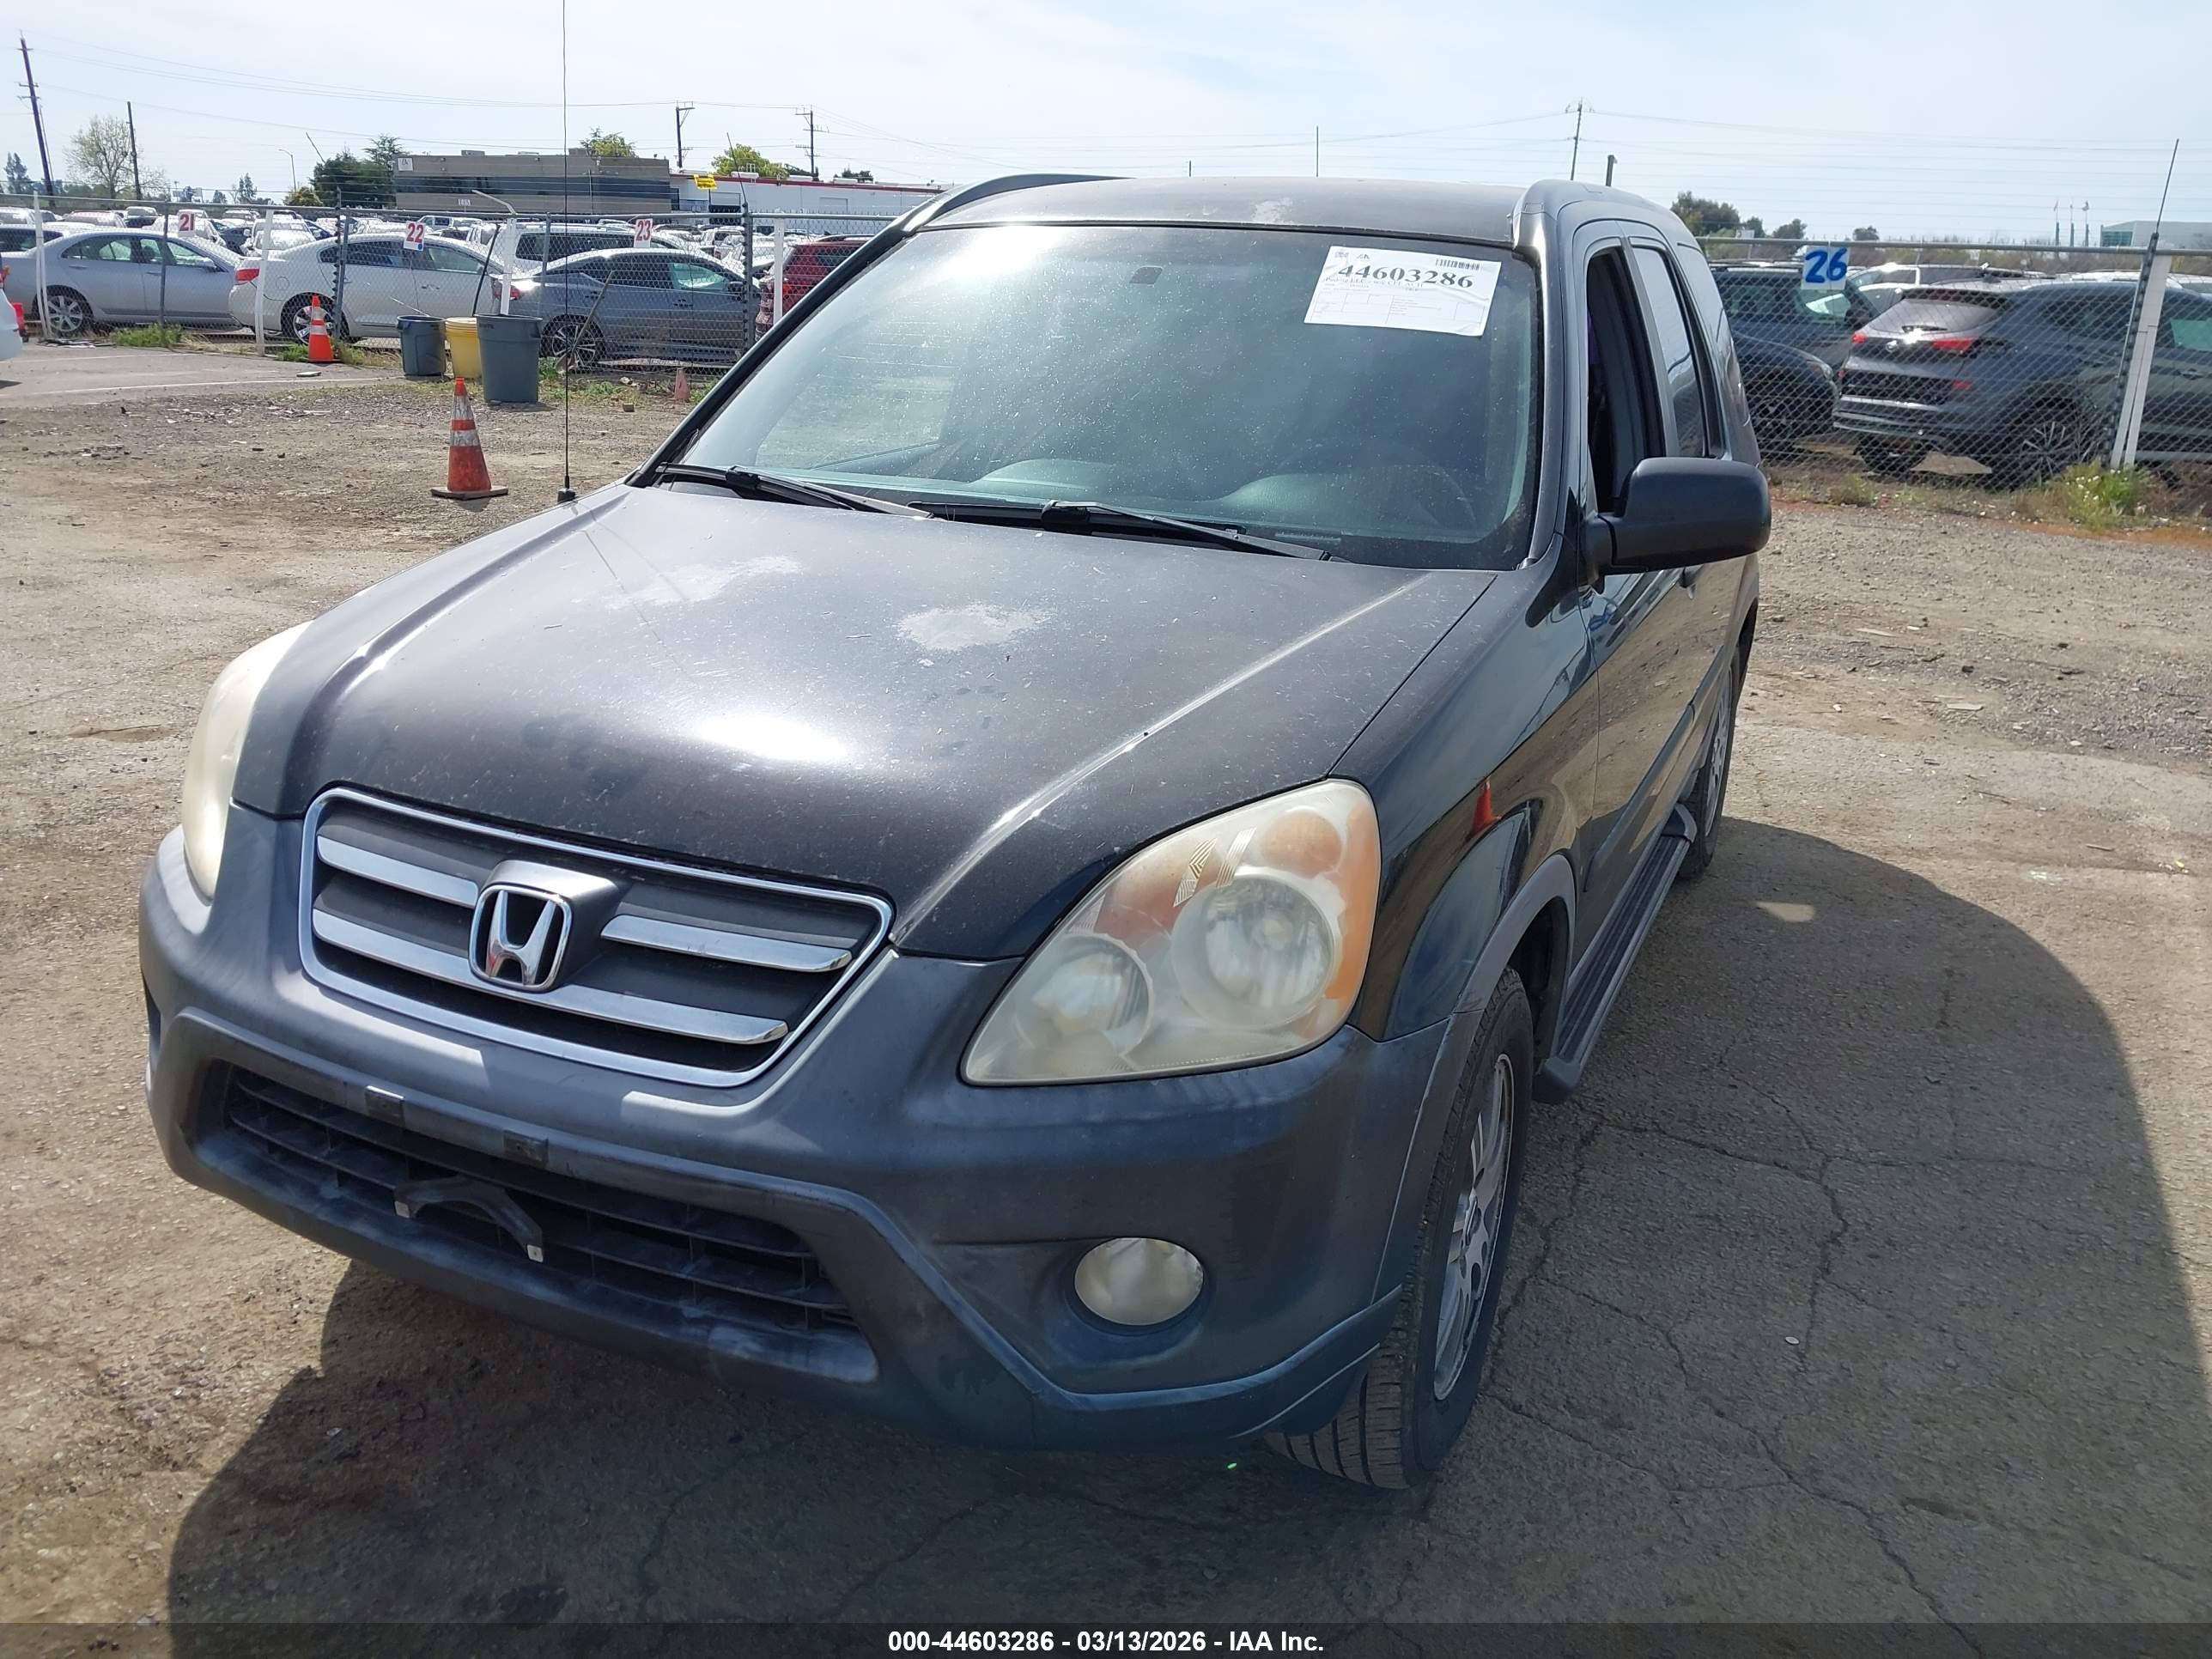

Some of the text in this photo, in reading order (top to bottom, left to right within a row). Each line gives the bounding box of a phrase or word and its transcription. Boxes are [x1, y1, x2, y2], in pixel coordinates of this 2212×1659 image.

[179, 214, 195, 232] 21
[405, 222, 424, 244] 22
[635, 220, 651, 241] 23
[1805, 246, 1848, 283] 26
[1338, 264, 1474, 289] 44603286
